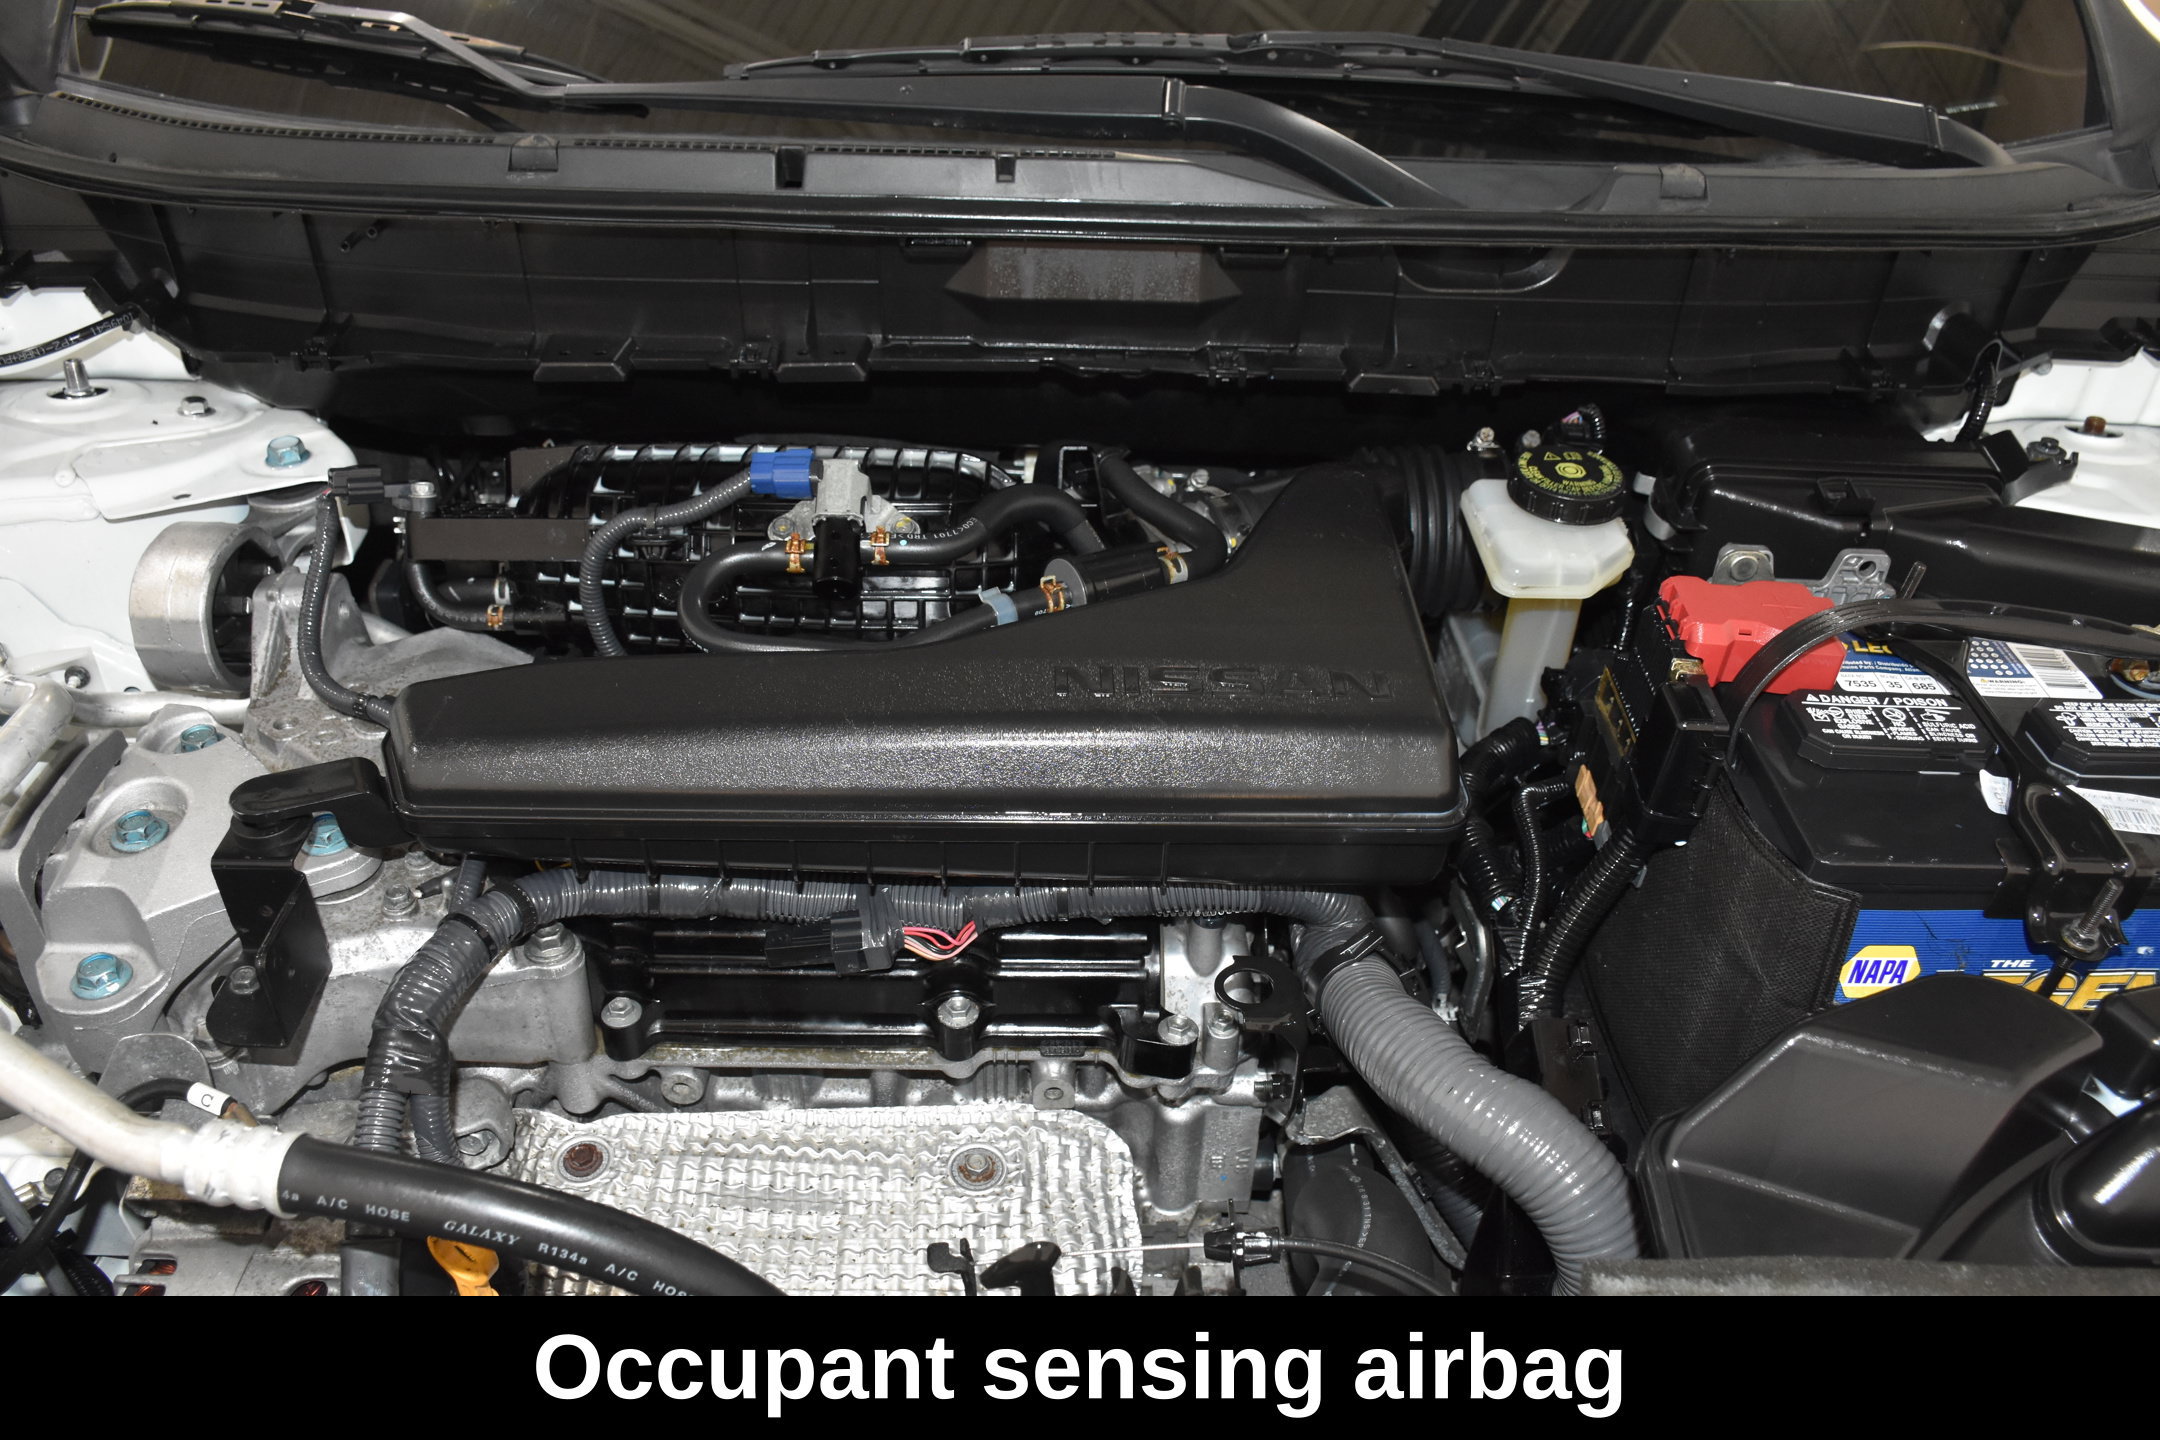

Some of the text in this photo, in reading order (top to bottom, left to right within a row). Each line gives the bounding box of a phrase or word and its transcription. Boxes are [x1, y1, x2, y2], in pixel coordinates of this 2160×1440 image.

[1053, 664, 1394, 699] NISSAN
[1844, 679, 1878, 688] 7535
[1886, 680, 1903, 689] 35
[1912, 682, 1936, 691] 685
[1819, 694, 1878, 705] DANGER
[1893, 697, 1950, 707] POISON
[1922, 722, 1956, 730] SULFURIC
[1990, 959, 2036, 969] THE
[1847, 959, 1909, 984] NAPA
[200, 1094, 214, 1108] C
[316, 1195, 348, 1210] A/C
[365, 1204, 410, 1222] HOSE
[444, 1220, 694, 1296] GALAXY R134a A/C HOS
